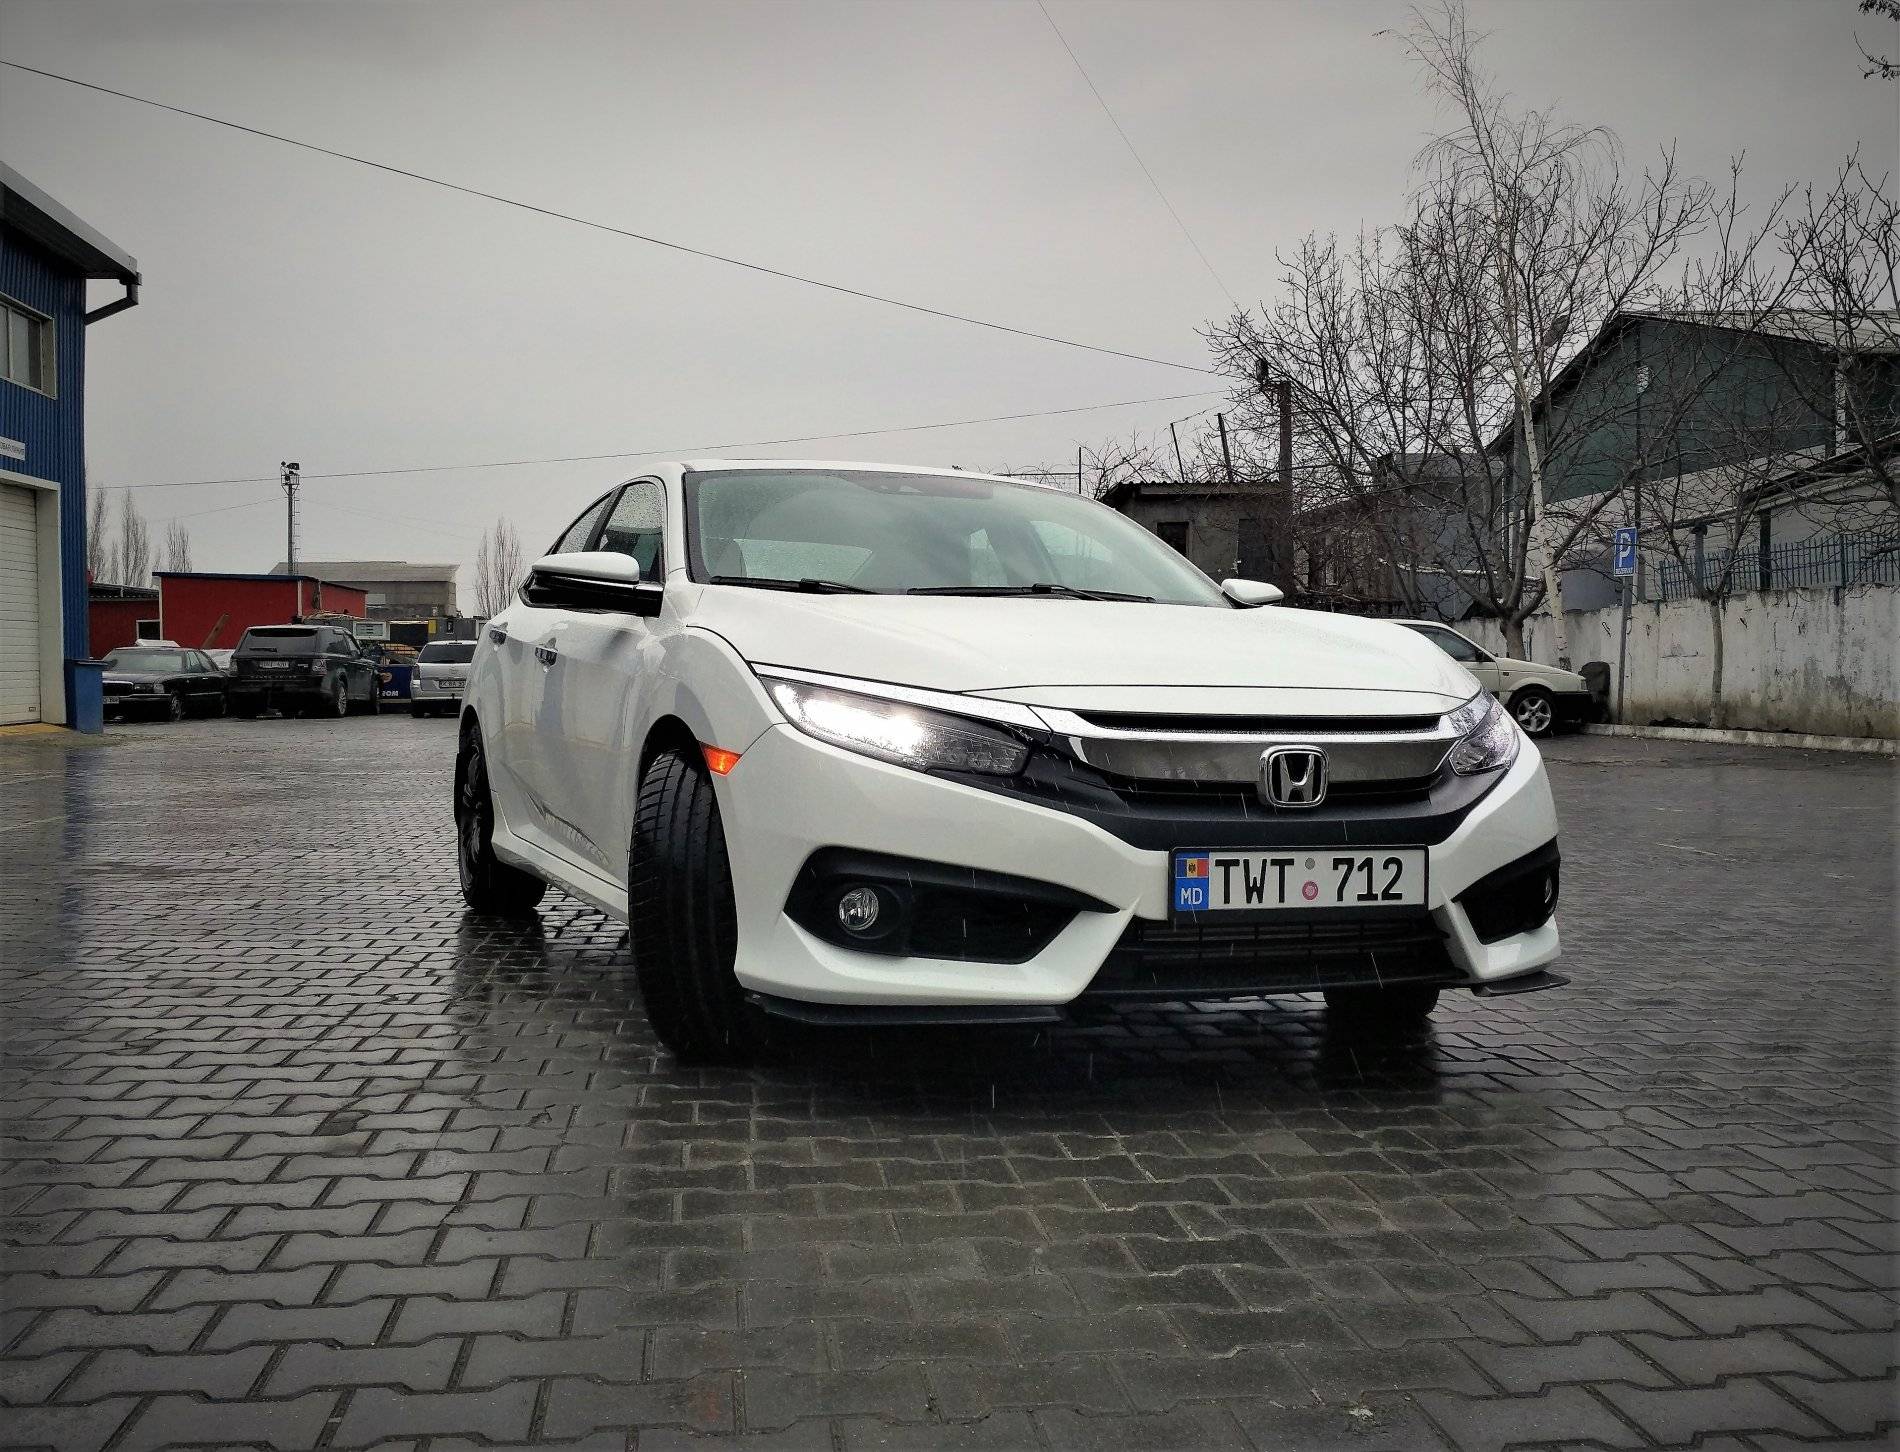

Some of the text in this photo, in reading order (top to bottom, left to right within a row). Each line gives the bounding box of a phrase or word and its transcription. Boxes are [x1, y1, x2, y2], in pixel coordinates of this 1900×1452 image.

[1619, 532, 1631, 567] P
[1180, 887, 1203, 905] MD
[1214, 856, 1404, 905] TWT 712
